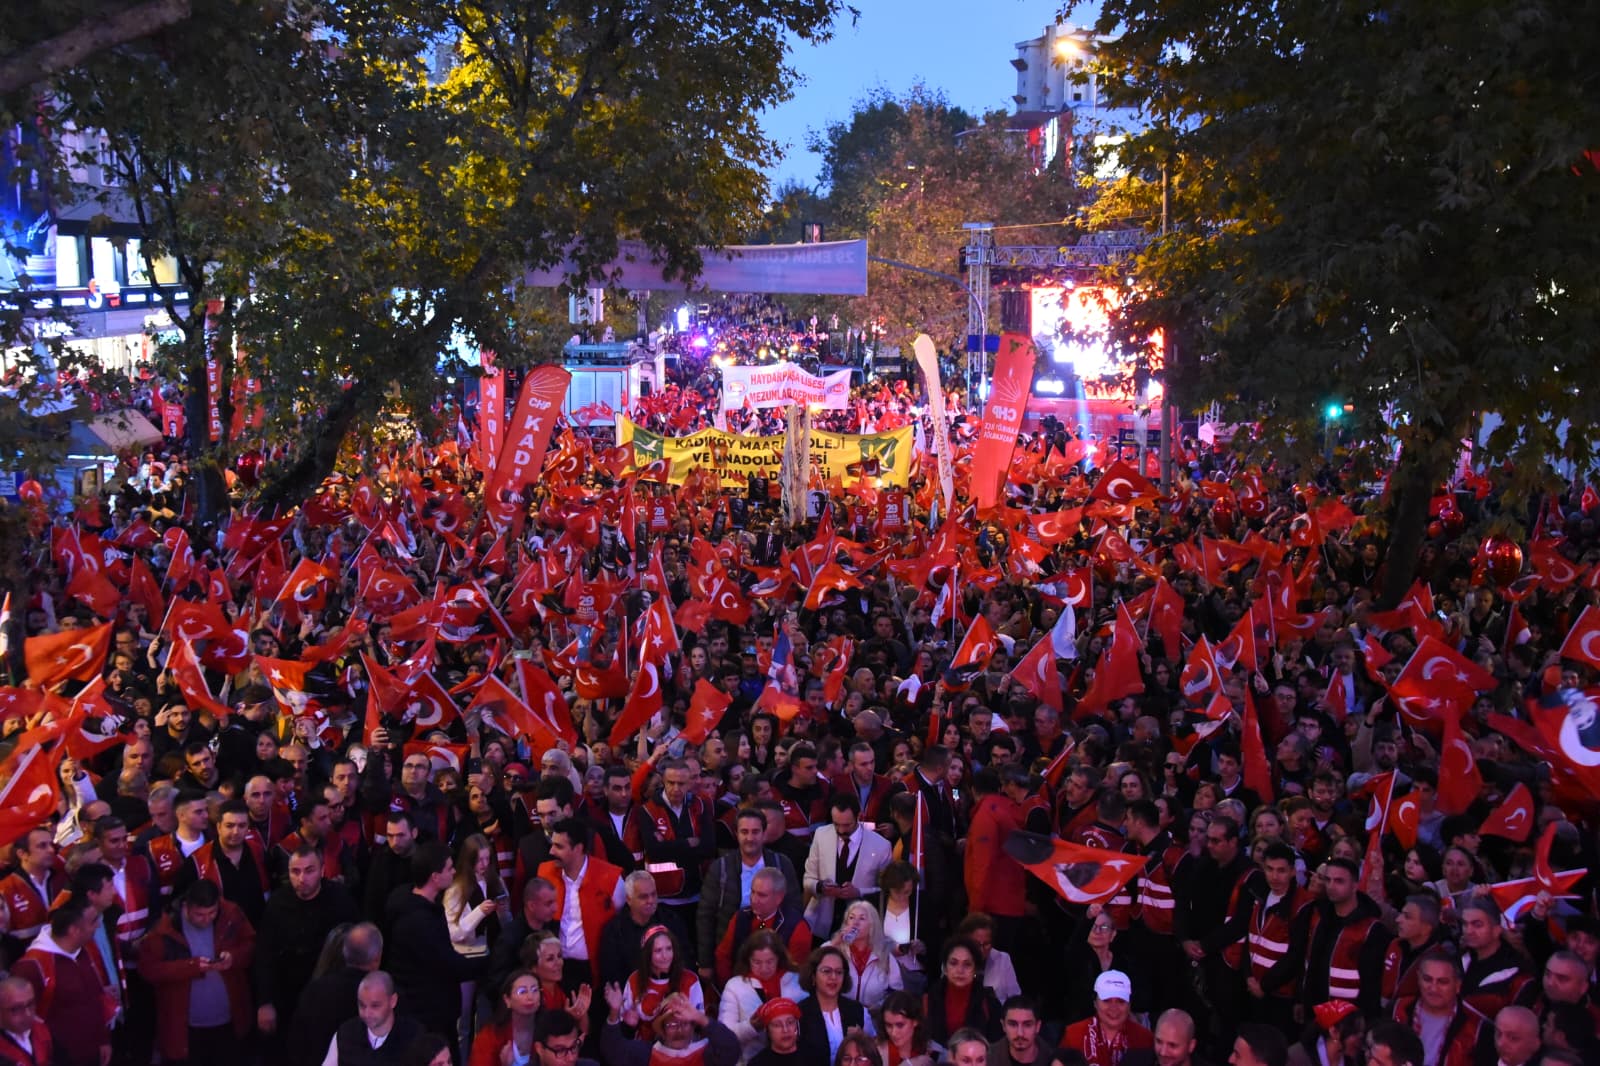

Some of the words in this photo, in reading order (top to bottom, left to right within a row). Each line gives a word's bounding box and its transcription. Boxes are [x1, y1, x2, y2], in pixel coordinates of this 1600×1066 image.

[528, 397, 552, 410] CHP
[739, 437, 785, 450] MAARİ
[693, 452, 709, 463] VE
[885, 504, 898, 513] 29
[578, 595, 595, 606] 29
